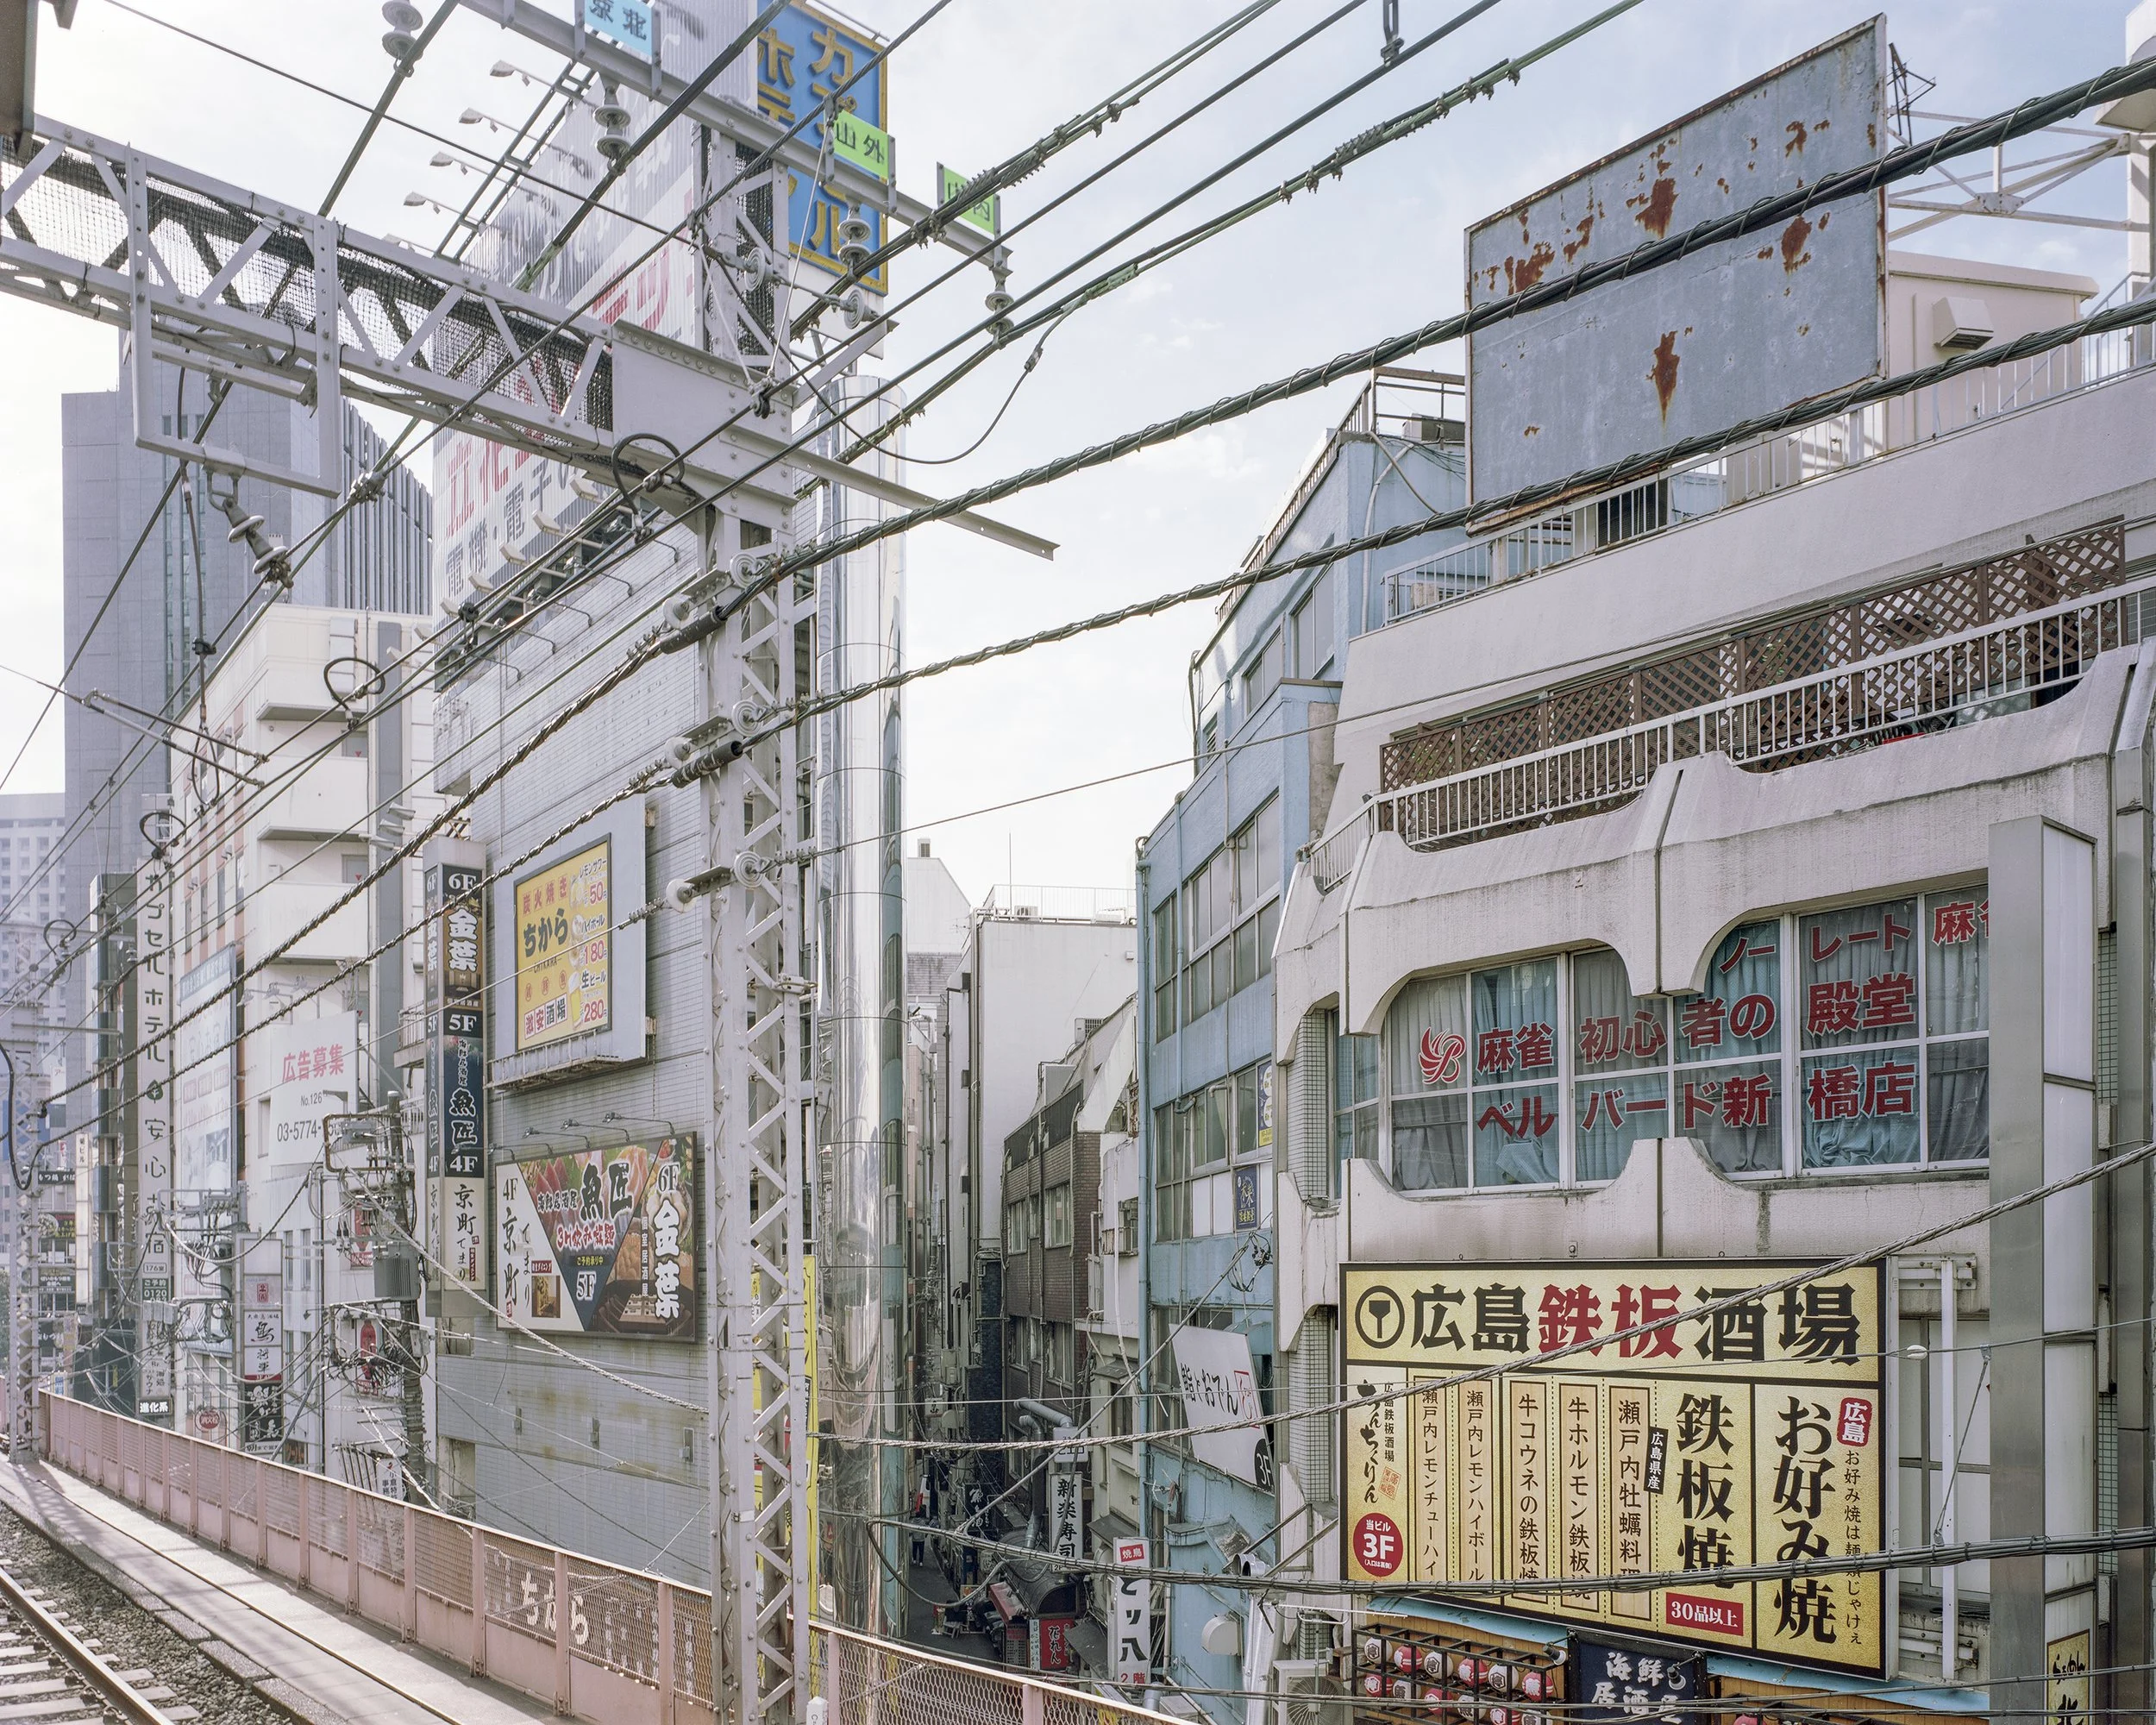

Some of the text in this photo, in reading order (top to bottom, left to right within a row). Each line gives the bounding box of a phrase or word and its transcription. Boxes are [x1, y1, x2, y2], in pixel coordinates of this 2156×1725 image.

[448, 873, 477, 891] 6F
[523, 907, 567, 957] ちから
[449, 1015, 476, 1032] 5F
[282, 1044, 344, 1083] 広告募集
[1476, 1021, 1556, 1075] 麻雀
[449, 1088, 478, 1146] 魚匠
[1476, 1062, 1916, 1141] ベルバード新橋店
[429, 1155, 439, 1173] 4F
[450, 1155, 478, 1173] 4F
[658, 1164, 680, 1192] 6F
[454, 1183, 476, 1236] 京町
[503, 1177, 518, 1201] 4F
[580, 1161, 633, 1222] 魚匠
[502, 1207, 519, 1306] 京町
[576, 1272, 596, 1301] 5F
[1411, 1282, 1862, 1364] 広島鉄板酒場
[1841, 1402, 1868, 1444] 広島
[1257, 1452, 1272, 1487] 3F
[1423, 1389, 1439, 1577] 瀬戸内レモンチューハイ
[1648, 1431, 1664, 1490] 広島県産
[1467, 1390, 1485, 1582] 瀬戸内レモンハイボール
[1676, 1392, 1735, 1590] 鉄板焼
[1056, 1478, 1077, 1558] 新楽寿司
[1366, 1519, 1391, 1532] 当ビル
[1772, 1396, 1838, 1645] お好み焼
[1363, 1533, 1395, 1560] 3F
[1671, 1601, 1739, 1628] 30品以上
[1606, 1652, 1664, 1687] 海鮮
